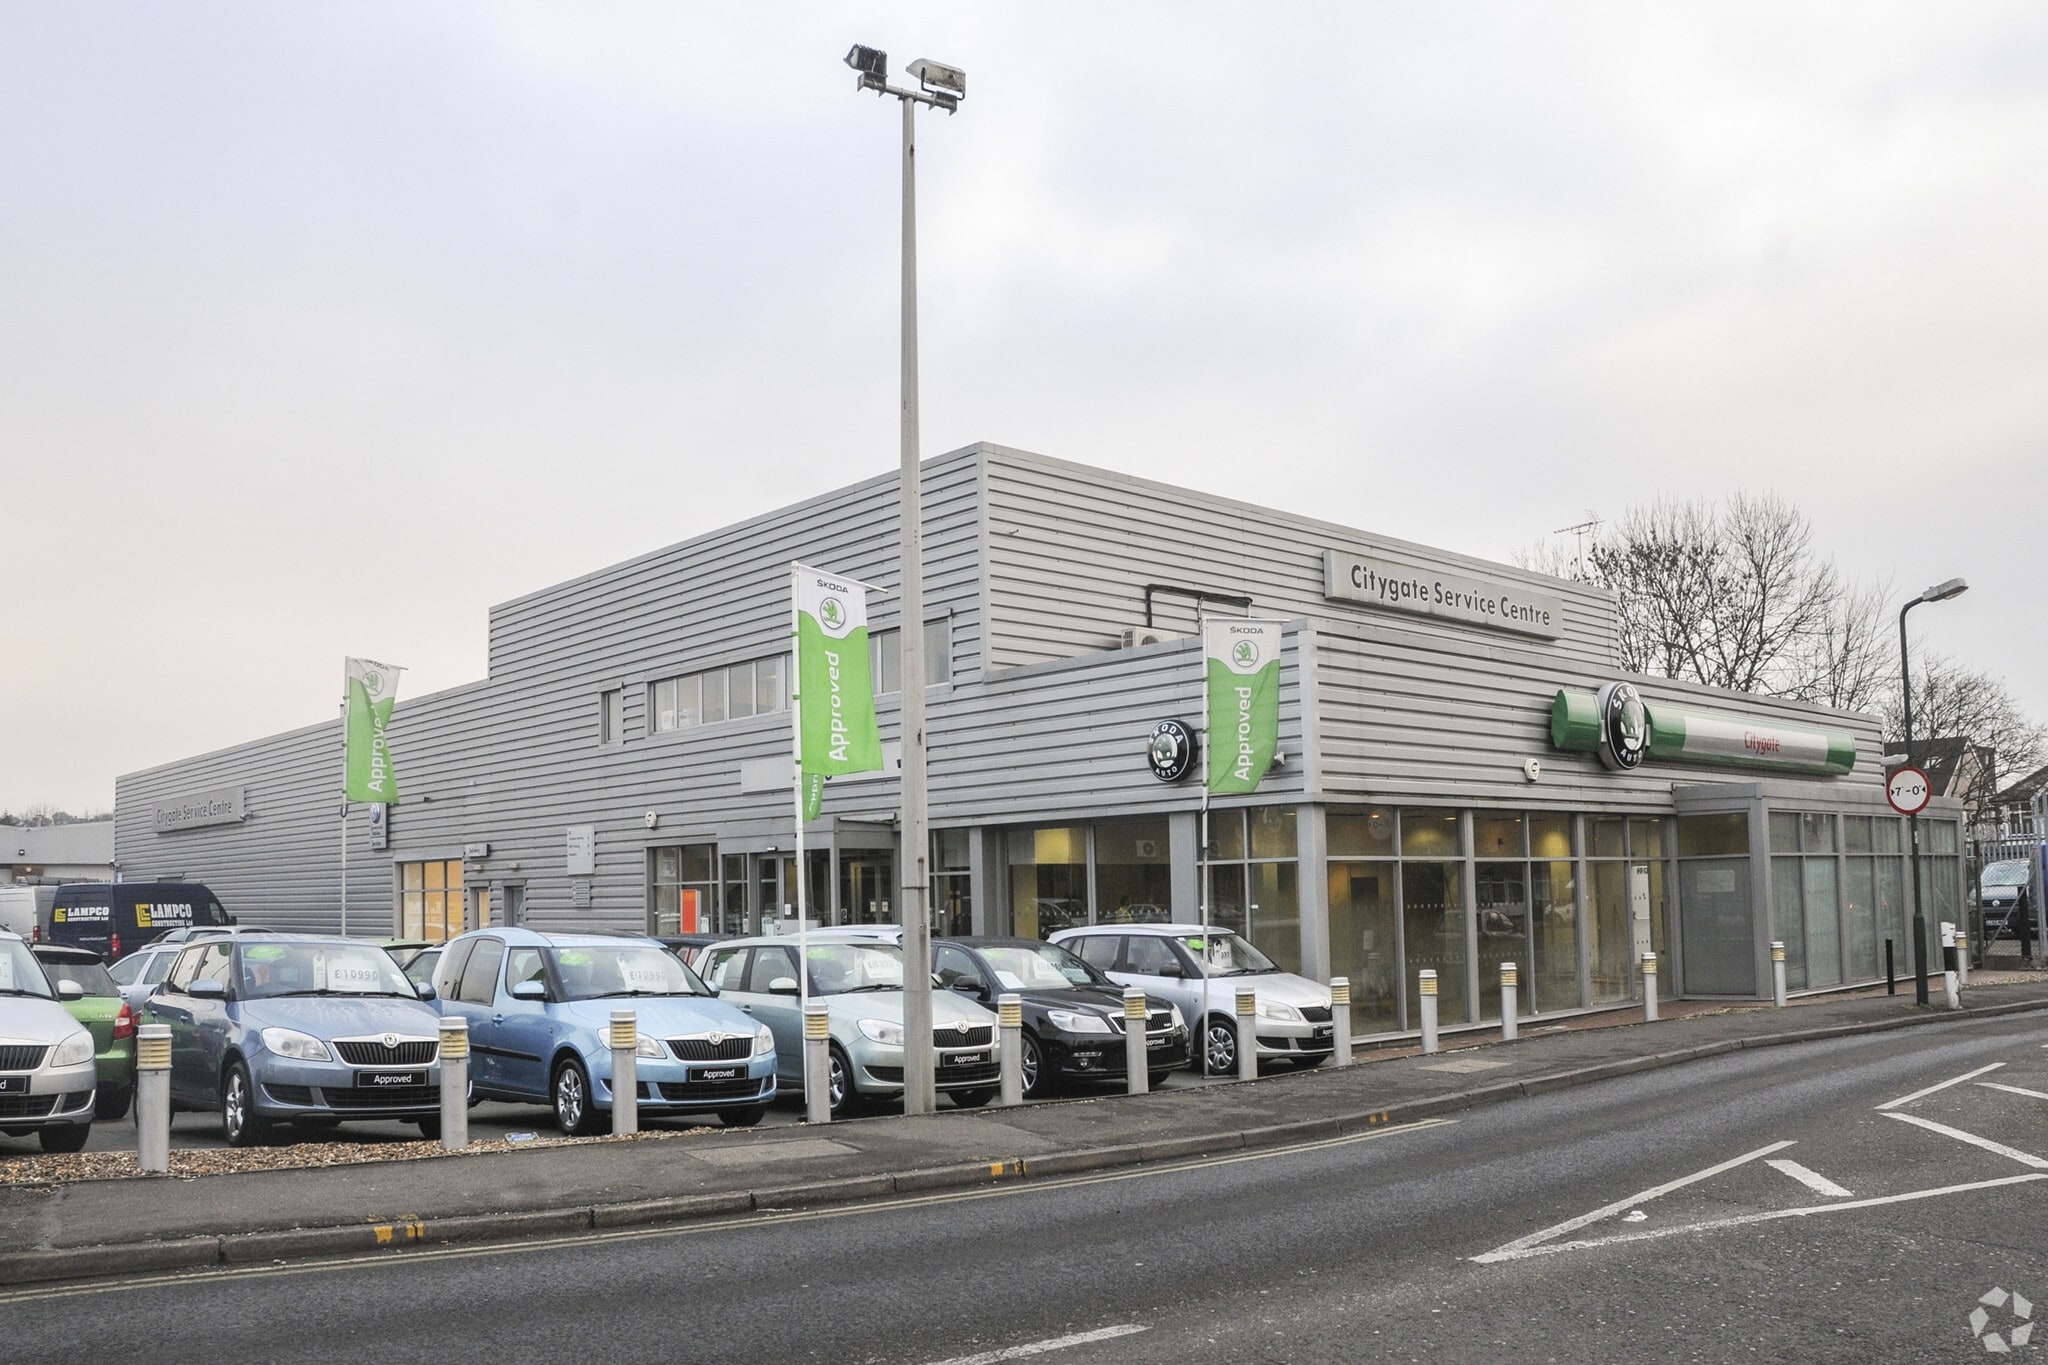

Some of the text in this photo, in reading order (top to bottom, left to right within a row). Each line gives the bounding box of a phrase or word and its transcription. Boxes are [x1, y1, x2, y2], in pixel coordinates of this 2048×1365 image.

[1351, 564, 1550, 626] Citygate Service Centre
[825, 650, 851, 762] Approved
[1234, 687, 1254, 781] Approved
[367, 705, 388, 793] Approve
[1744, 731, 1780, 755] Citygate
[1621, 749, 1643, 762] AUTO
[1155, 766, 1178, 777] AUTO
[157, 799, 233, 827] Citygate Service Centre
[67, 907, 110, 917] LAMPCO
[150, 903, 193, 918] LAMPCO
[1145, 1037, 1165, 1046] pproved
[954, 1053, 981, 1064] Approved
[374, 1073, 412, 1085] Approved
[703, 1068, 735, 1079] Approved
